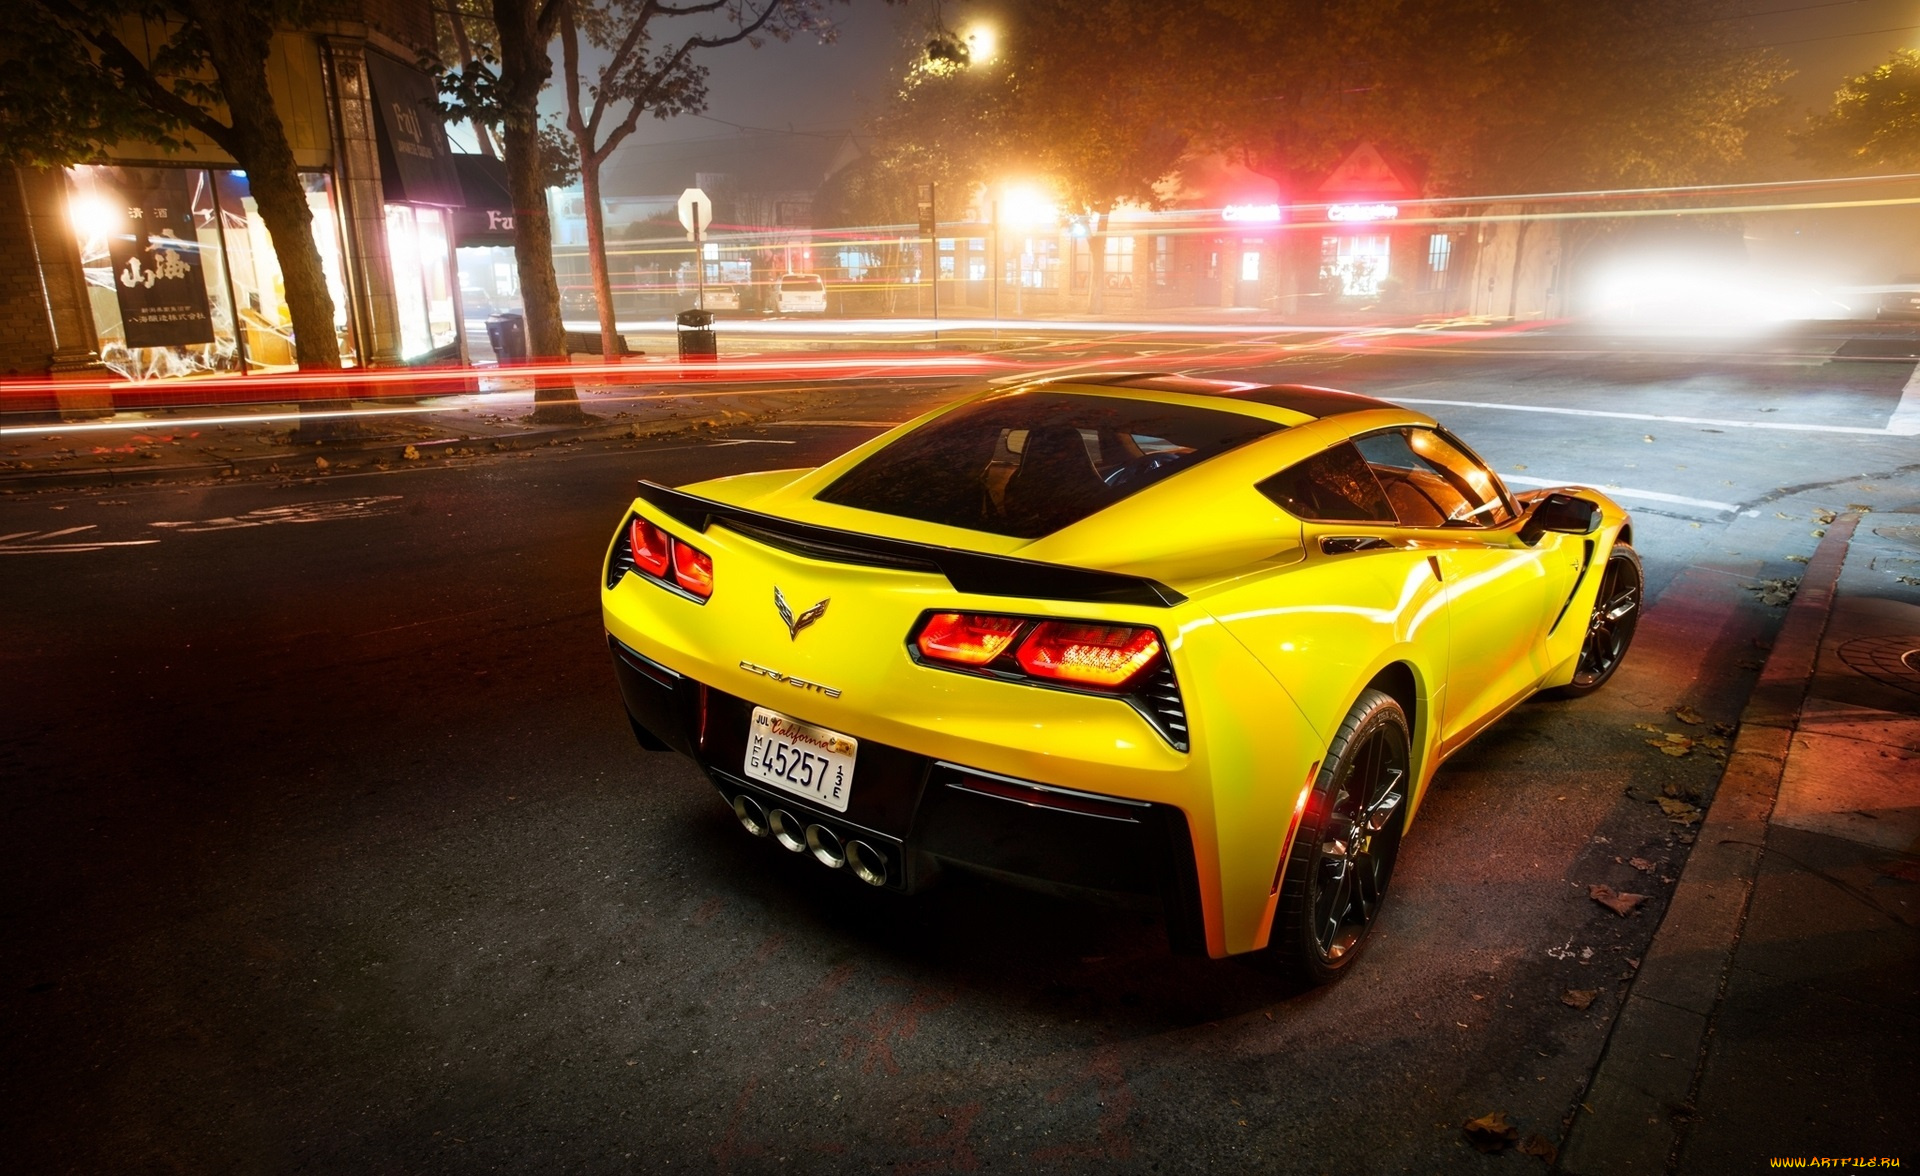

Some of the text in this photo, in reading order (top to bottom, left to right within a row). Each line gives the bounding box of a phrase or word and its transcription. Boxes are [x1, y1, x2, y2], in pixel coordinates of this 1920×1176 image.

[1077, 273, 1133, 289] YGA
[739, 660, 842, 699] CORVETTE
[756, 715, 769, 727] JUL
[771, 718, 836, 754] California
[762, 739, 830, 793] 45257
